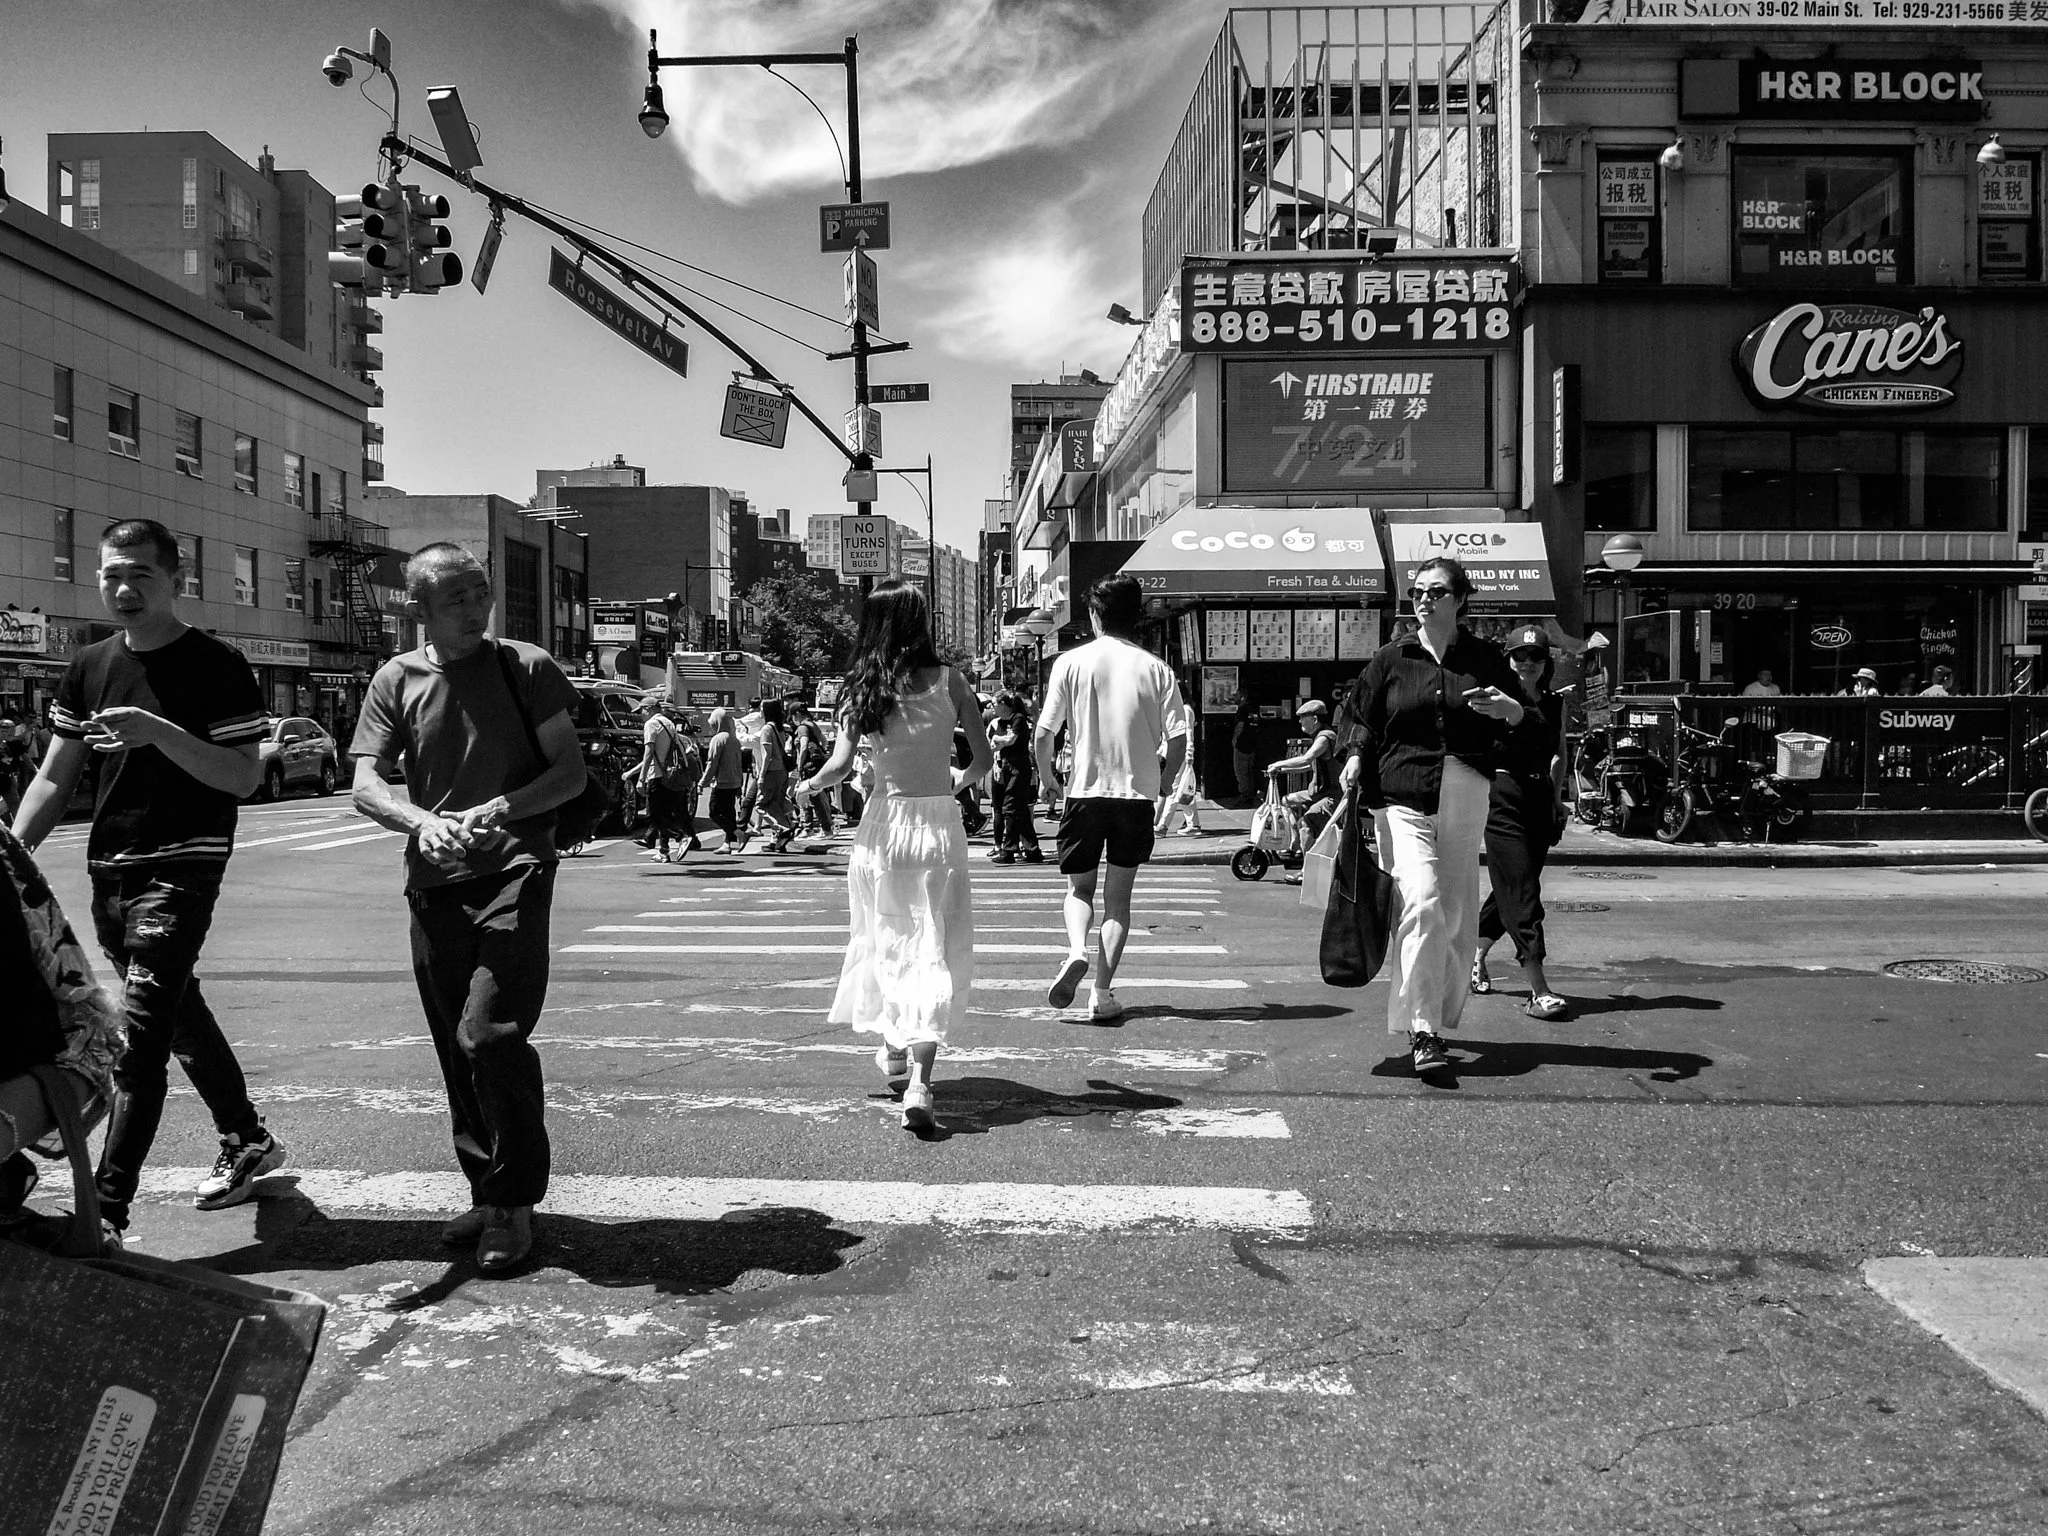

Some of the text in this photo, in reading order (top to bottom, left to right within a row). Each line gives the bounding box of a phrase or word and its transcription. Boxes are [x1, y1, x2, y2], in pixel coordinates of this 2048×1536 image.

[1684, 0, 1750, 17] SALON
[1757, 1, 1798, 17] 39-02
[1804, 2, 1839, 17] Main
[1844, 2, 1863, 17] St.
[1873, 1, 1898, 18] Tel:
[1903, 2, 2003, 19] 929-231-5566
[1760, 71, 1984, 100] H&R BLOCK
[1601, 167, 1653, 180] 公司成立
[1606, 183, 1647, 203] 报税
[1984, 181, 2023, 201] 报税
[845, 207, 885, 217] MUNICIPAL
[1743, 201, 1778, 214] H&R
[845, 218, 877, 227] PARKING
[1743, 216, 1800, 229] BLOCK
[1779, 249, 1895, 266] H&R BLOCK
[1193, 270, 1509, 306] 生意贷款 房屋贷款
[565, 269, 673, 359] Roosevelt Av
[1828, 309, 1900, 330] Raising
[1192, 307, 1510, 343] 888-510-1218
[1753, 303, 1961, 399] Cane's
[1304, 372, 1434, 396] FIRSTRADE
[731, 390, 785, 411] DON'T BLOCK
[884, 387, 906, 400] Main
[1823, 388, 1940, 401] CHICKEN FINGERS
[740, 403, 774, 419] THE BOX
[1301, 397, 1428, 421] 第一證券
[1067, 430, 1088, 438] HAIR
[1073, 438, 1085, 470] SALON
[1271, 421, 1418, 484] 7/24
[855, 522, 874, 534] NO
[844, 537, 885, 548] TURNS
[1325, 539, 1365, 553] 都可
[1428, 531, 1487, 549] Lyca
[1457, 547, 1488, 555] Mobile
[1267, 576, 1378, 587] Fresh Tea & Juice
[1464, 569, 1541, 580] ORLD NY INC
[1714, 593, 1756, 609] 39 20
[1815, 631, 1847, 643] OPEN
[1879, 711, 1955, 731] Subway
[62, 1460, 94, 1514] Brooklyn,
[86, 1435, 101, 1455] NY
[95, 1397, 117, 1433] 11235
[89, 1461, 113, 1497] YOU
[106, 1412, 133, 1457] LOVE
[204, 1456, 228, 1487] YOU
[220, 1415, 247, 1454] LOVE
